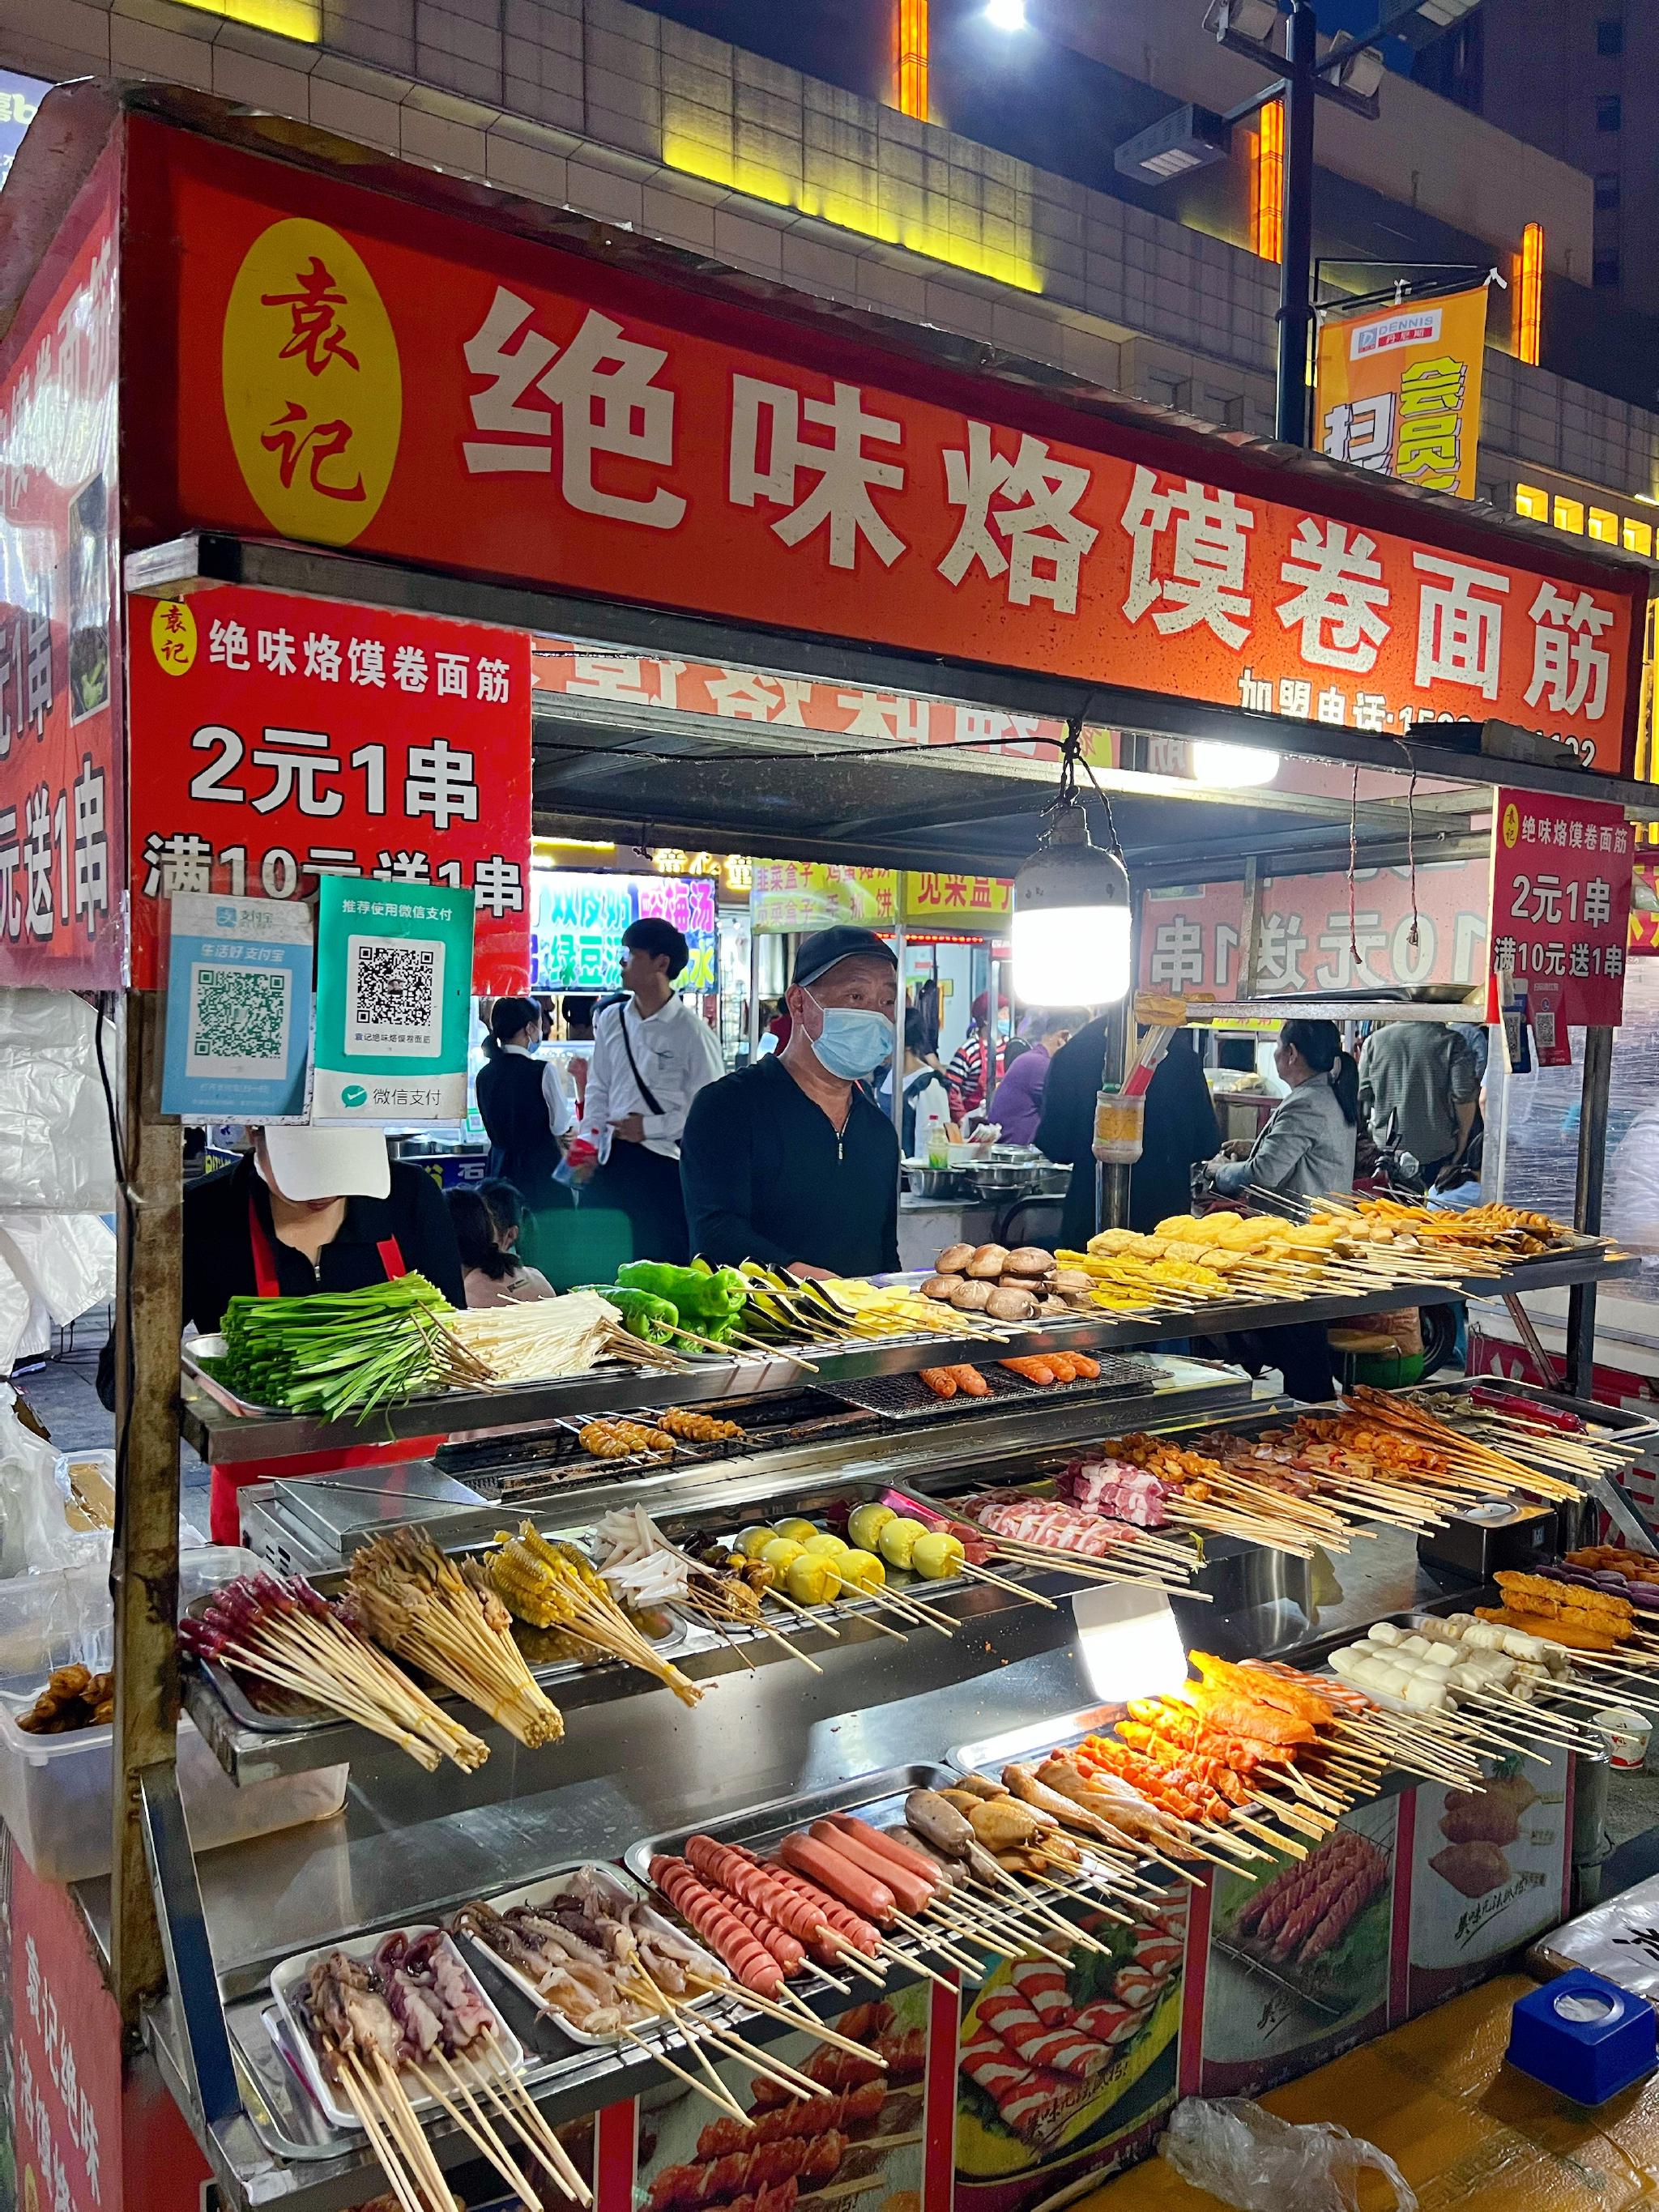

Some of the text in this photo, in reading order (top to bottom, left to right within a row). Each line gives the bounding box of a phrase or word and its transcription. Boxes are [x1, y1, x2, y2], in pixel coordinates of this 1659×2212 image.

[1379, 316, 1434, 335] DENNIS
[261, 256, 367, 501] 袁记
[463, 285, 1614, 720] 绝味烙馍卷面筋
[160, 606, 190, 665] 袁记
[209, 618, 510, 704] 绝味烙馍卷面筋
[190, 725, 480, 829] 2元1串
[1506, 808, 1516, 842] 袁记
[1521, 815, 1628, 854] 绝味烙馍卷面筋
[757, 863, 813, 892] 韭菜盒子
[342, 899, 453, 922] 推荐使用微信支付
[1510, 875, 1611, 928] 2元1串
[245, 947, 285, 962] 支付宝
[1493, 936, 1623, 978] 满10元送1串
[373, 1088, 441, 1106] 微信支付
